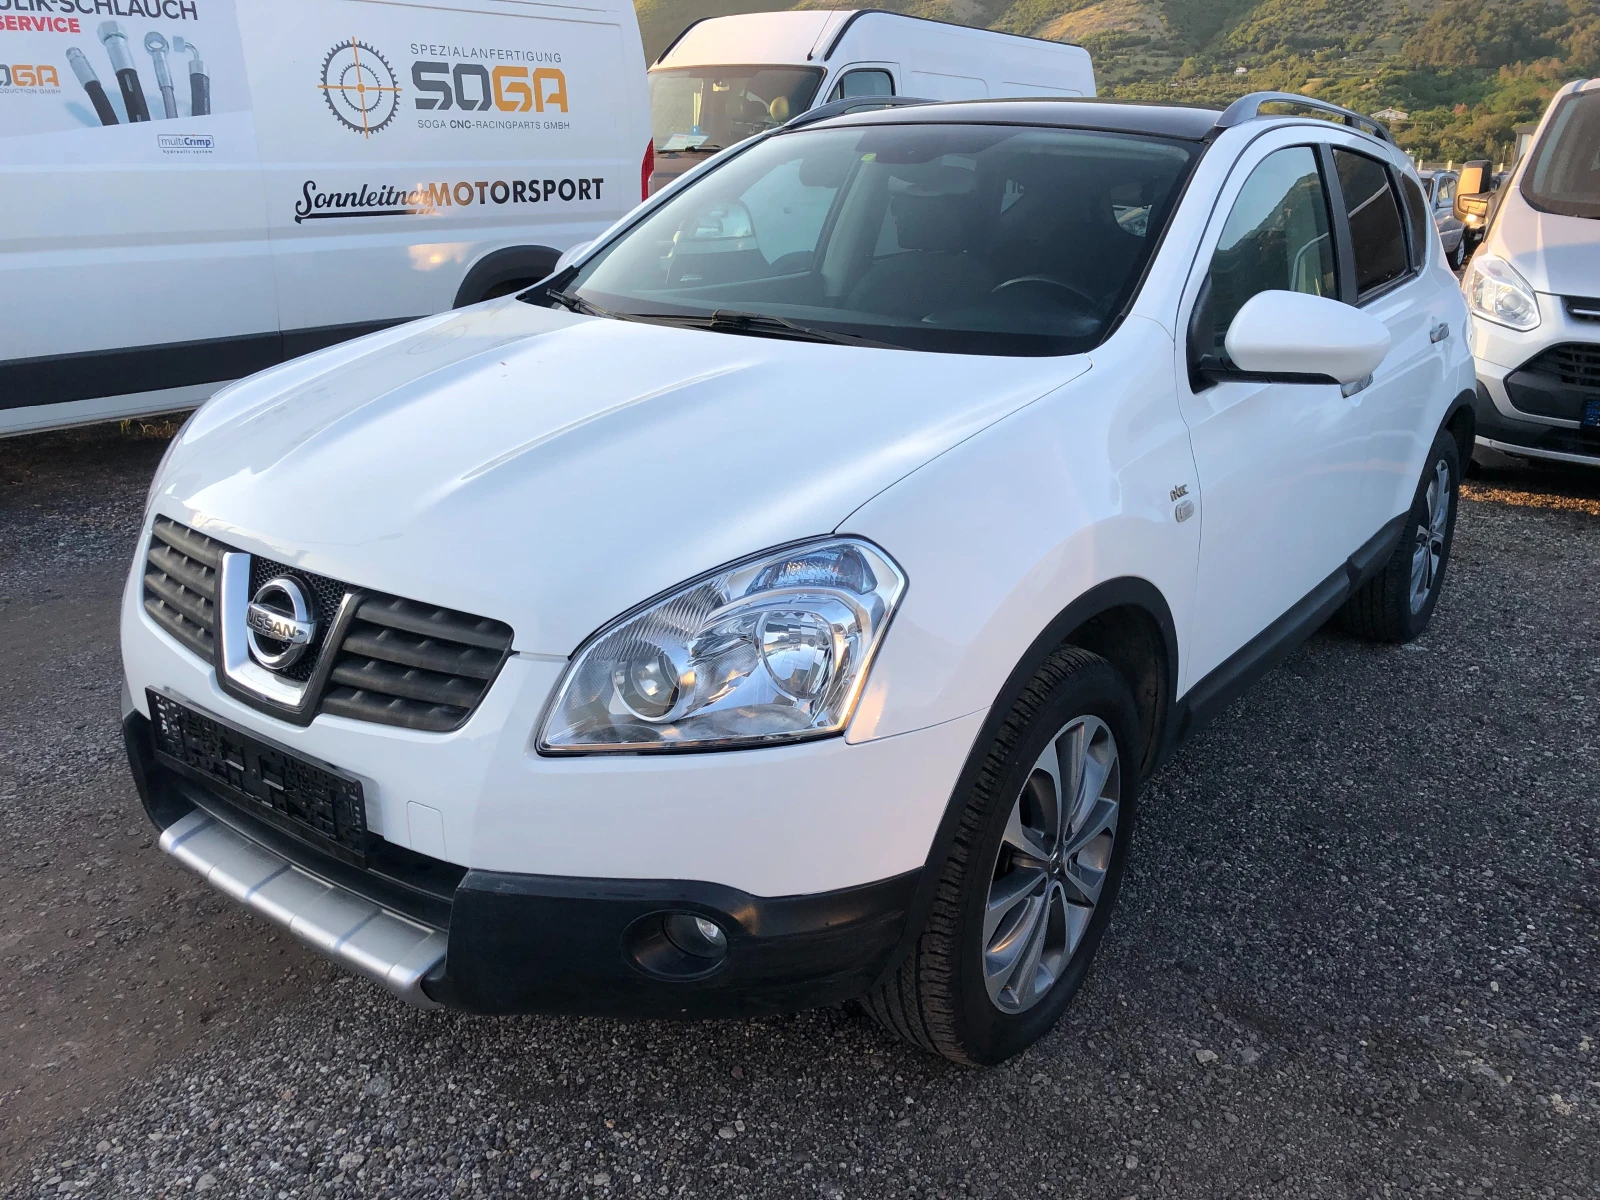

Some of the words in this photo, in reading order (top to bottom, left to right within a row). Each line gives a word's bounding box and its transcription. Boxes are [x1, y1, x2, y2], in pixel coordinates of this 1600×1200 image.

[410, 43, 562, 63] SPEZIALANFERTIGUNG
[411, 61, 569, 113] SOGA
[417, 120, 447, 129] SOGA
[450, 120, 541, 130] CNC-RACINGPARTS
[543, 121, 570, 130] GMBH
[428, 178, 604, 208] MOTORSPORT
[248, 611, 297, 638] NISSAN
